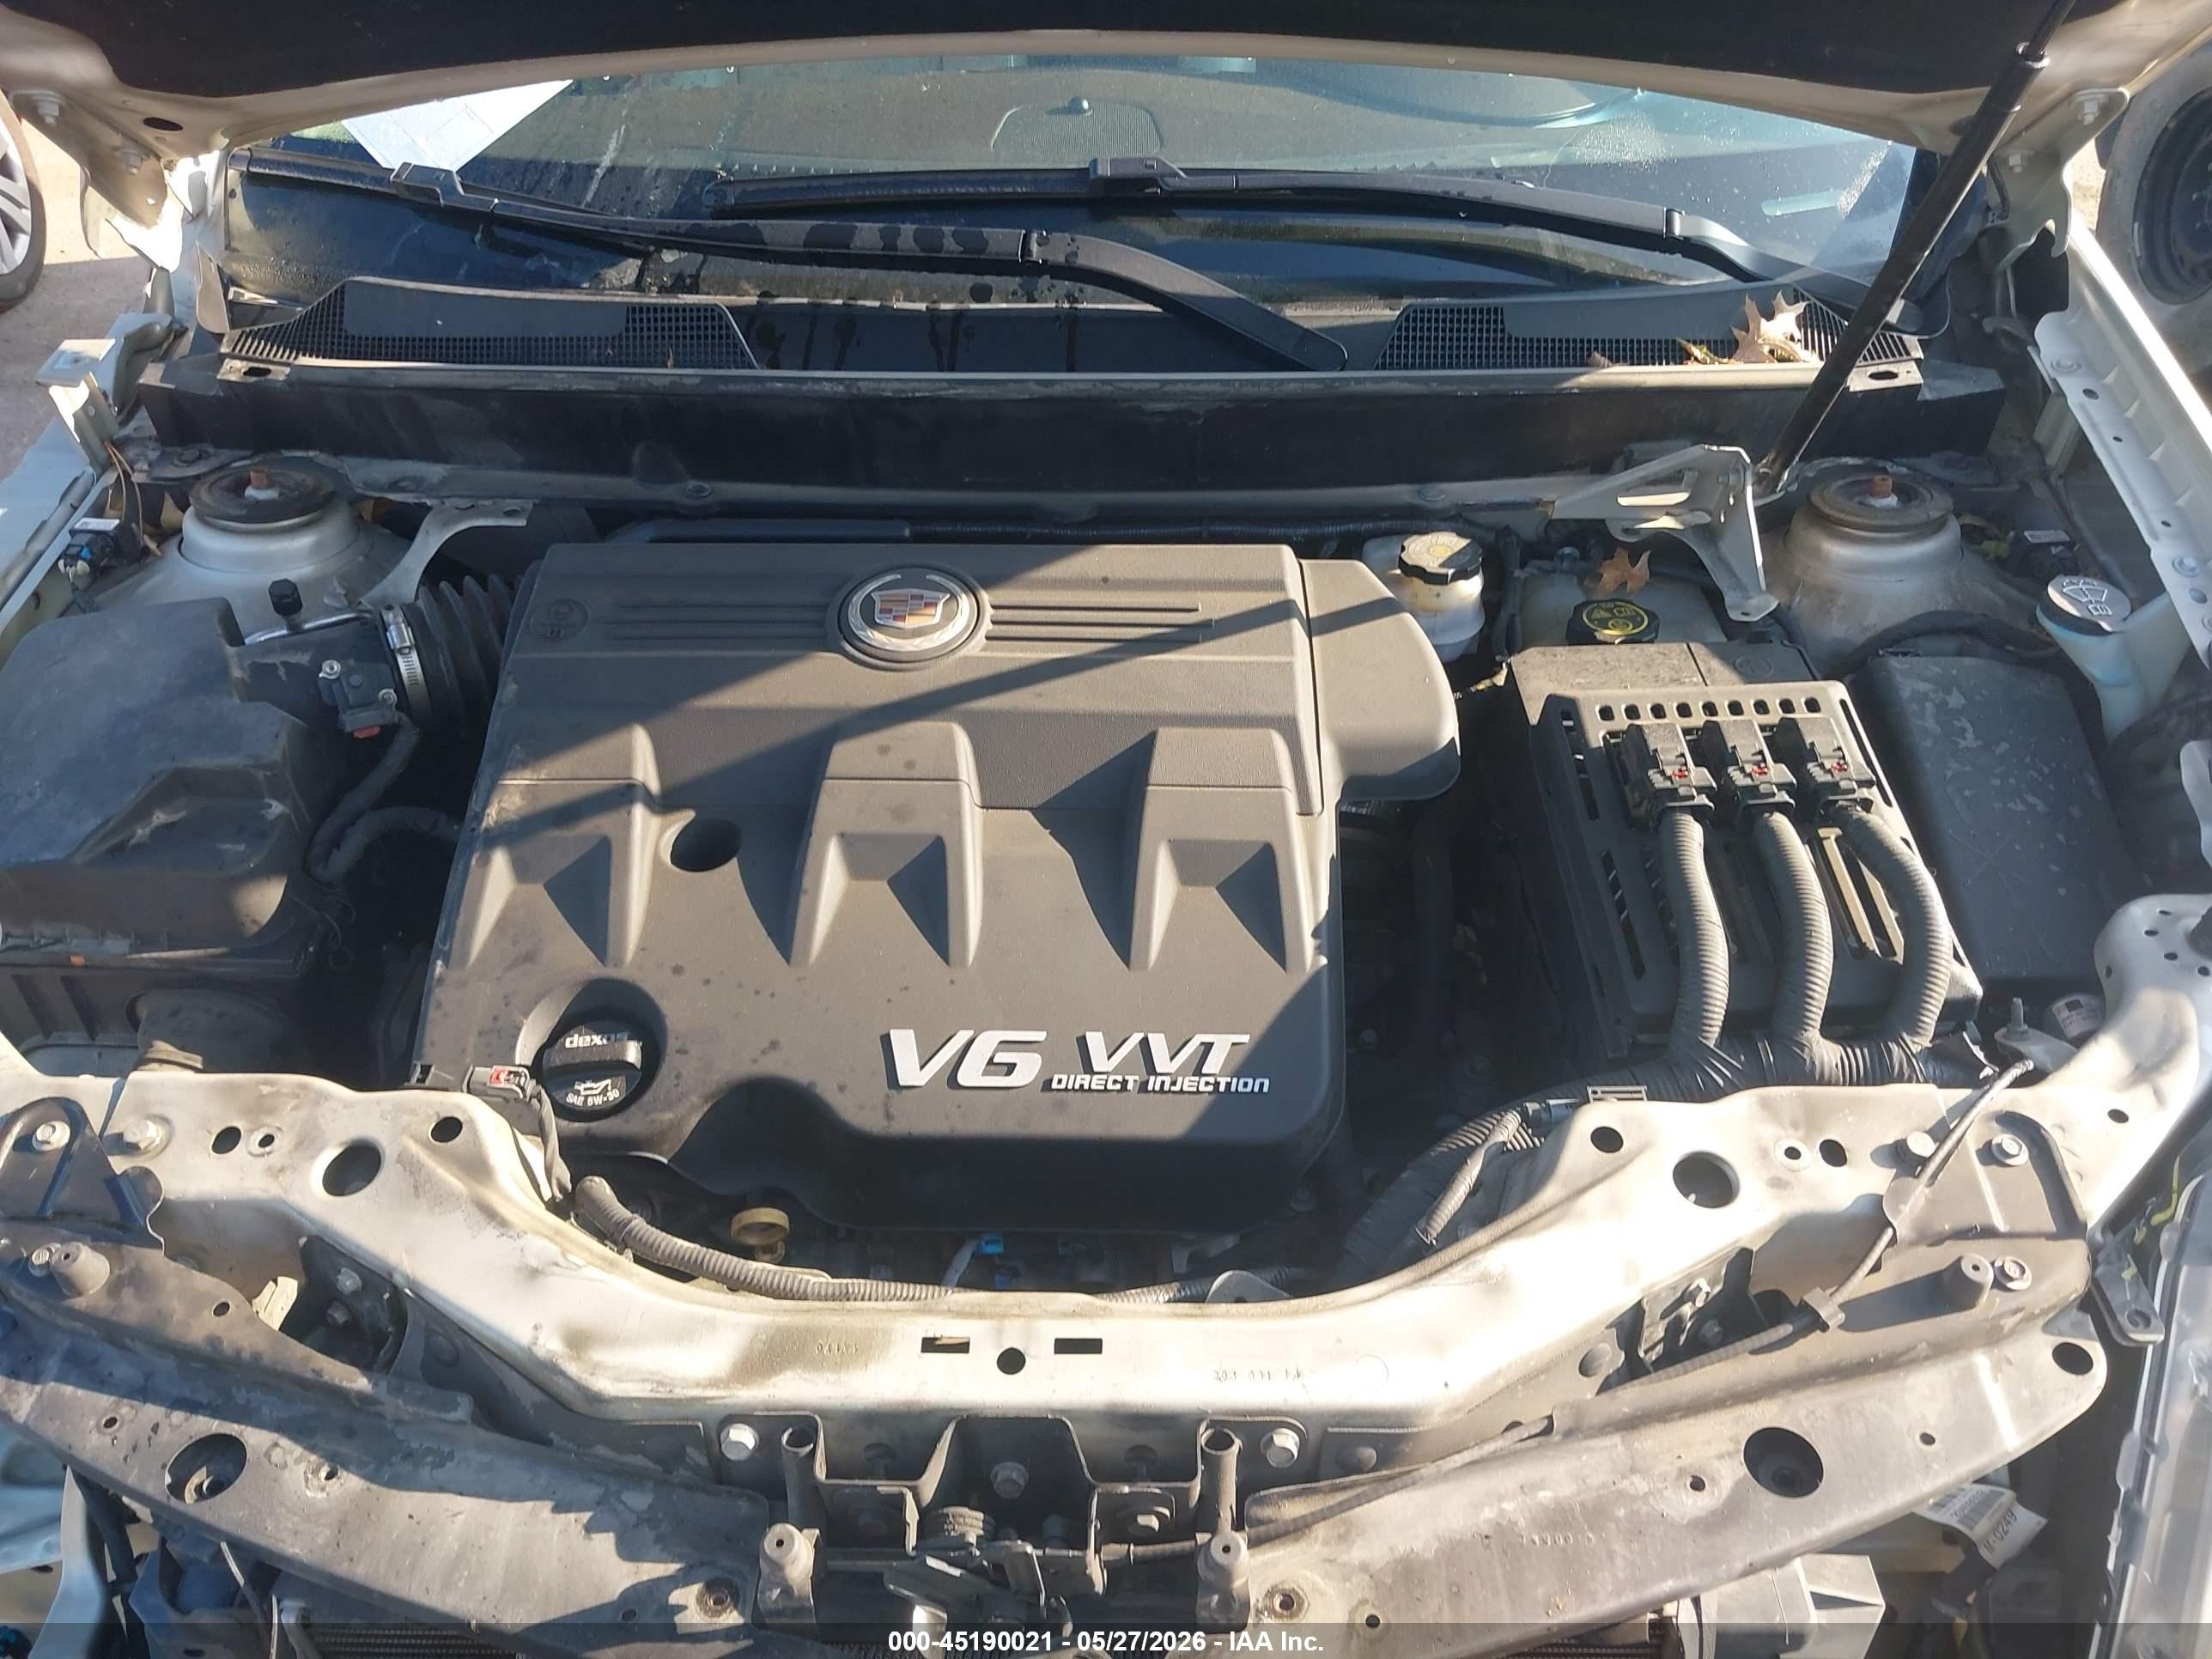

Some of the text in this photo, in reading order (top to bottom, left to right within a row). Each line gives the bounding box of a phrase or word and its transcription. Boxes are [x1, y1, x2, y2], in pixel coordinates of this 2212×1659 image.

[890, 1029, 1250, 1088] V6 VVT
[1051, 1073, 1270, 1093] DIRECT INJECTION
[566, 1091, 584, 1107] SAE
